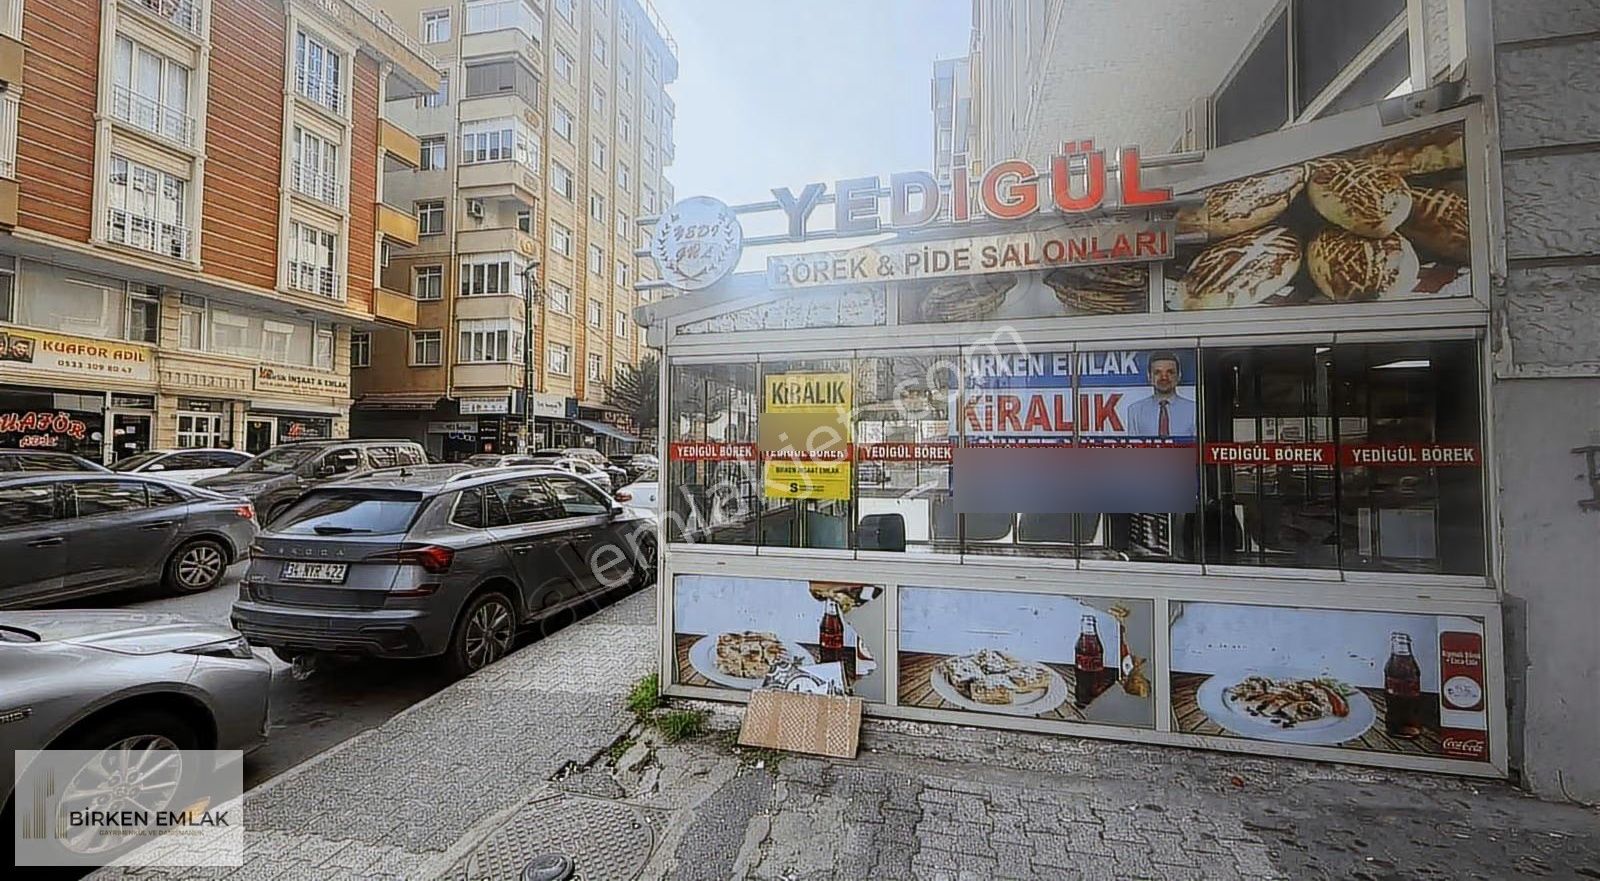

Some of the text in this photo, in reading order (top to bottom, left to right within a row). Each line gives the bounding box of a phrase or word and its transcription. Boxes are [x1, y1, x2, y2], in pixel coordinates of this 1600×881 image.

[771, 140, 1173, 242] YEDİGÜL
[777, 230, 1168, 284] BÖREK & PİDE SALONLARI
[772, 381, 846, 405] KİRALIK
[956, 393, 1126, 433] KİRALIK
[678, 443, 752, 457] YEDİGÜL BÖREK
[866, 444, 952, 459] YEDİGÜL BÖREK
[1211, 445, 1323, 461] YEDİGÜL BÖREK
[1352, 445, 1475, 462] YEDİGÜL BÖREK
[289, 563, 299, 576] 34
[326, 565, 345, 578] 422
